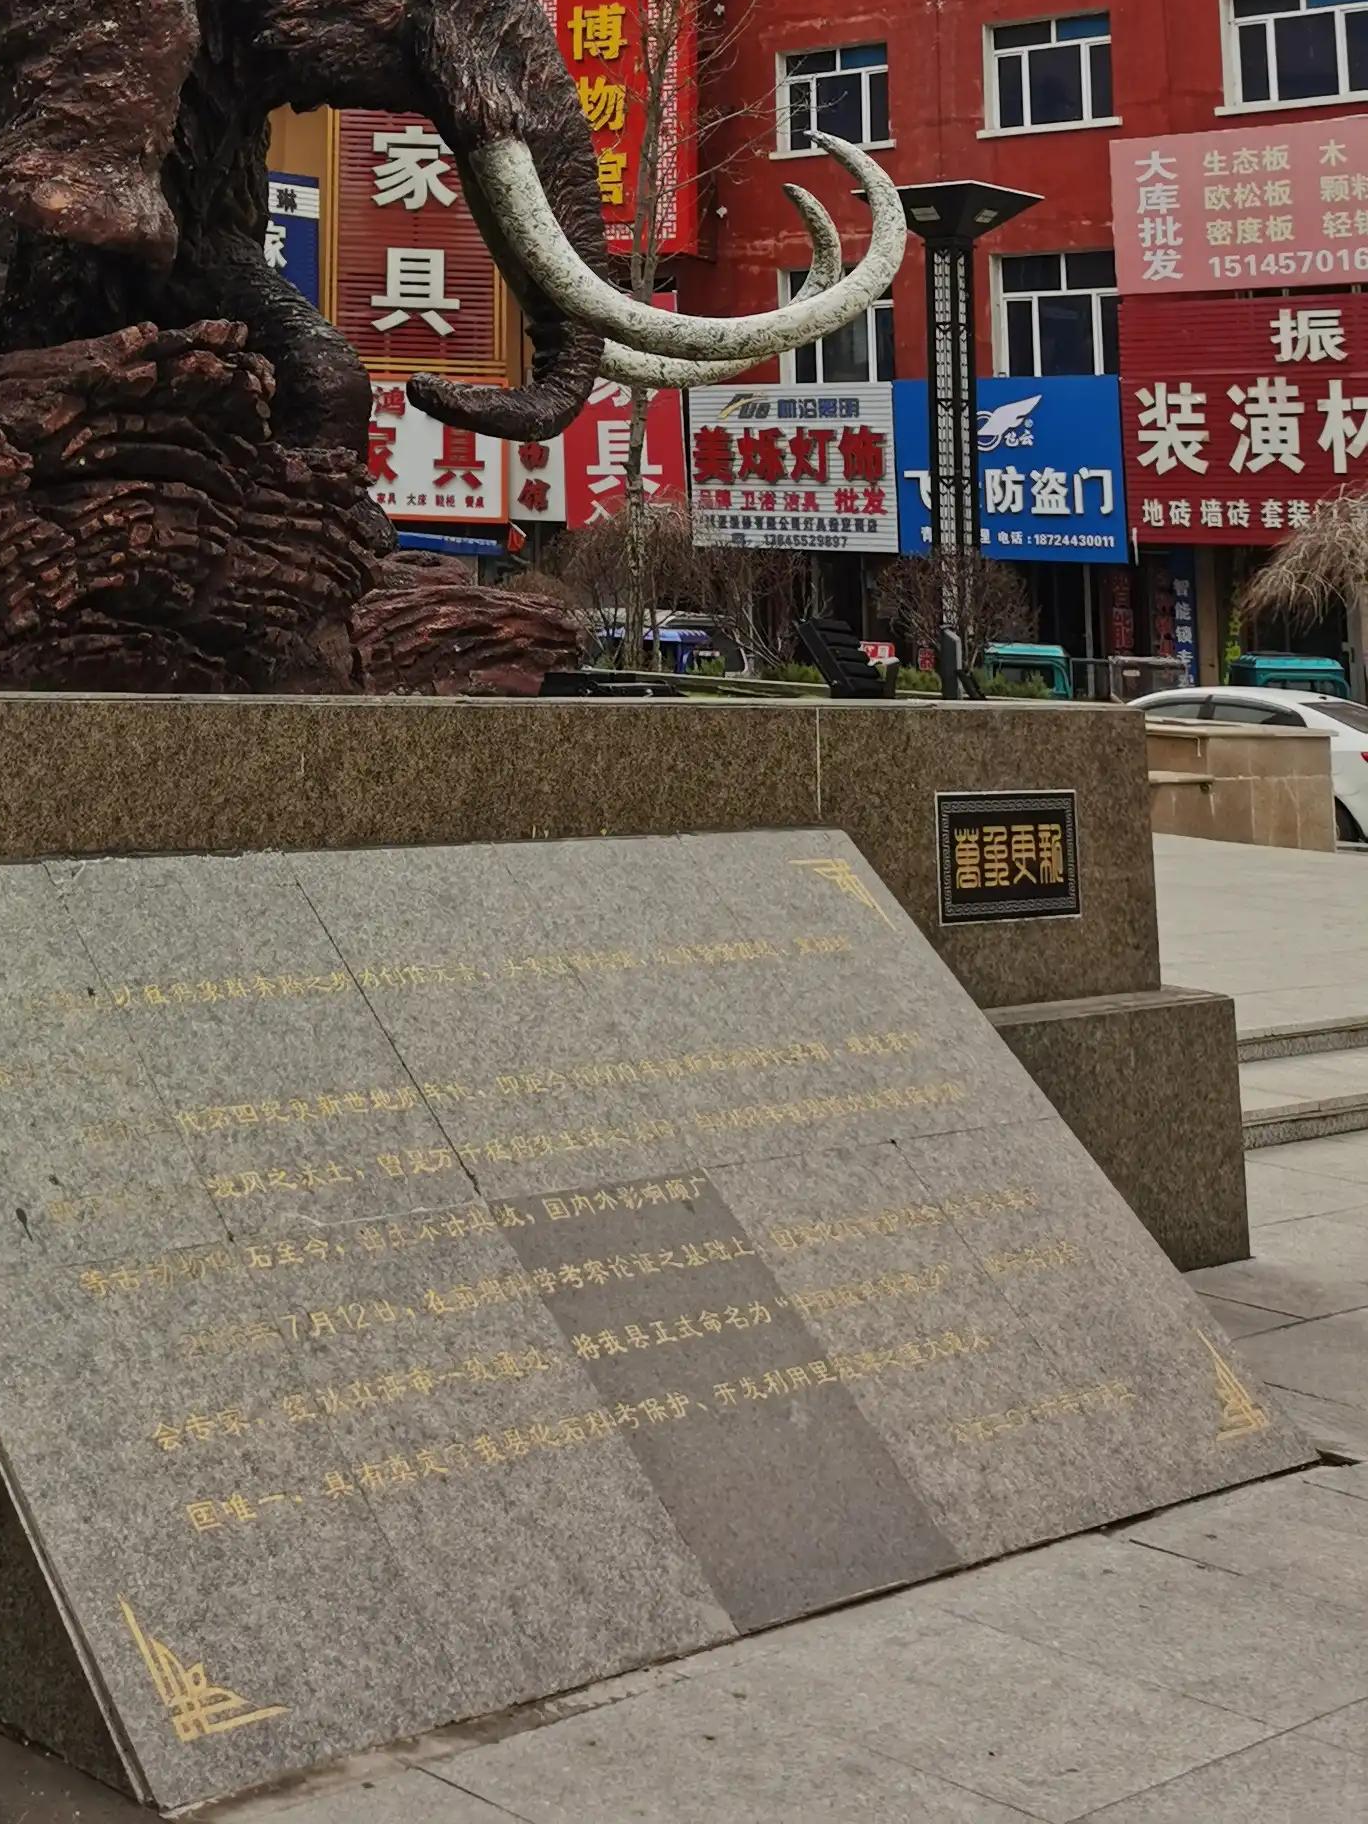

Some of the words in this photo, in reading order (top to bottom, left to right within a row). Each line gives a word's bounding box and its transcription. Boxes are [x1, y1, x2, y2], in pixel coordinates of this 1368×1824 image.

[1202, 144, 1291, 177] 生态板
[1203, 179, 1293, 211] 欧松板
[1206, 215, 1296, 246] 密度板
[1269, 308, 1349, 363] 振
[1142, 498, 1192, 528] 地砖
[1199, 498, 1251, 528] 墙砖
